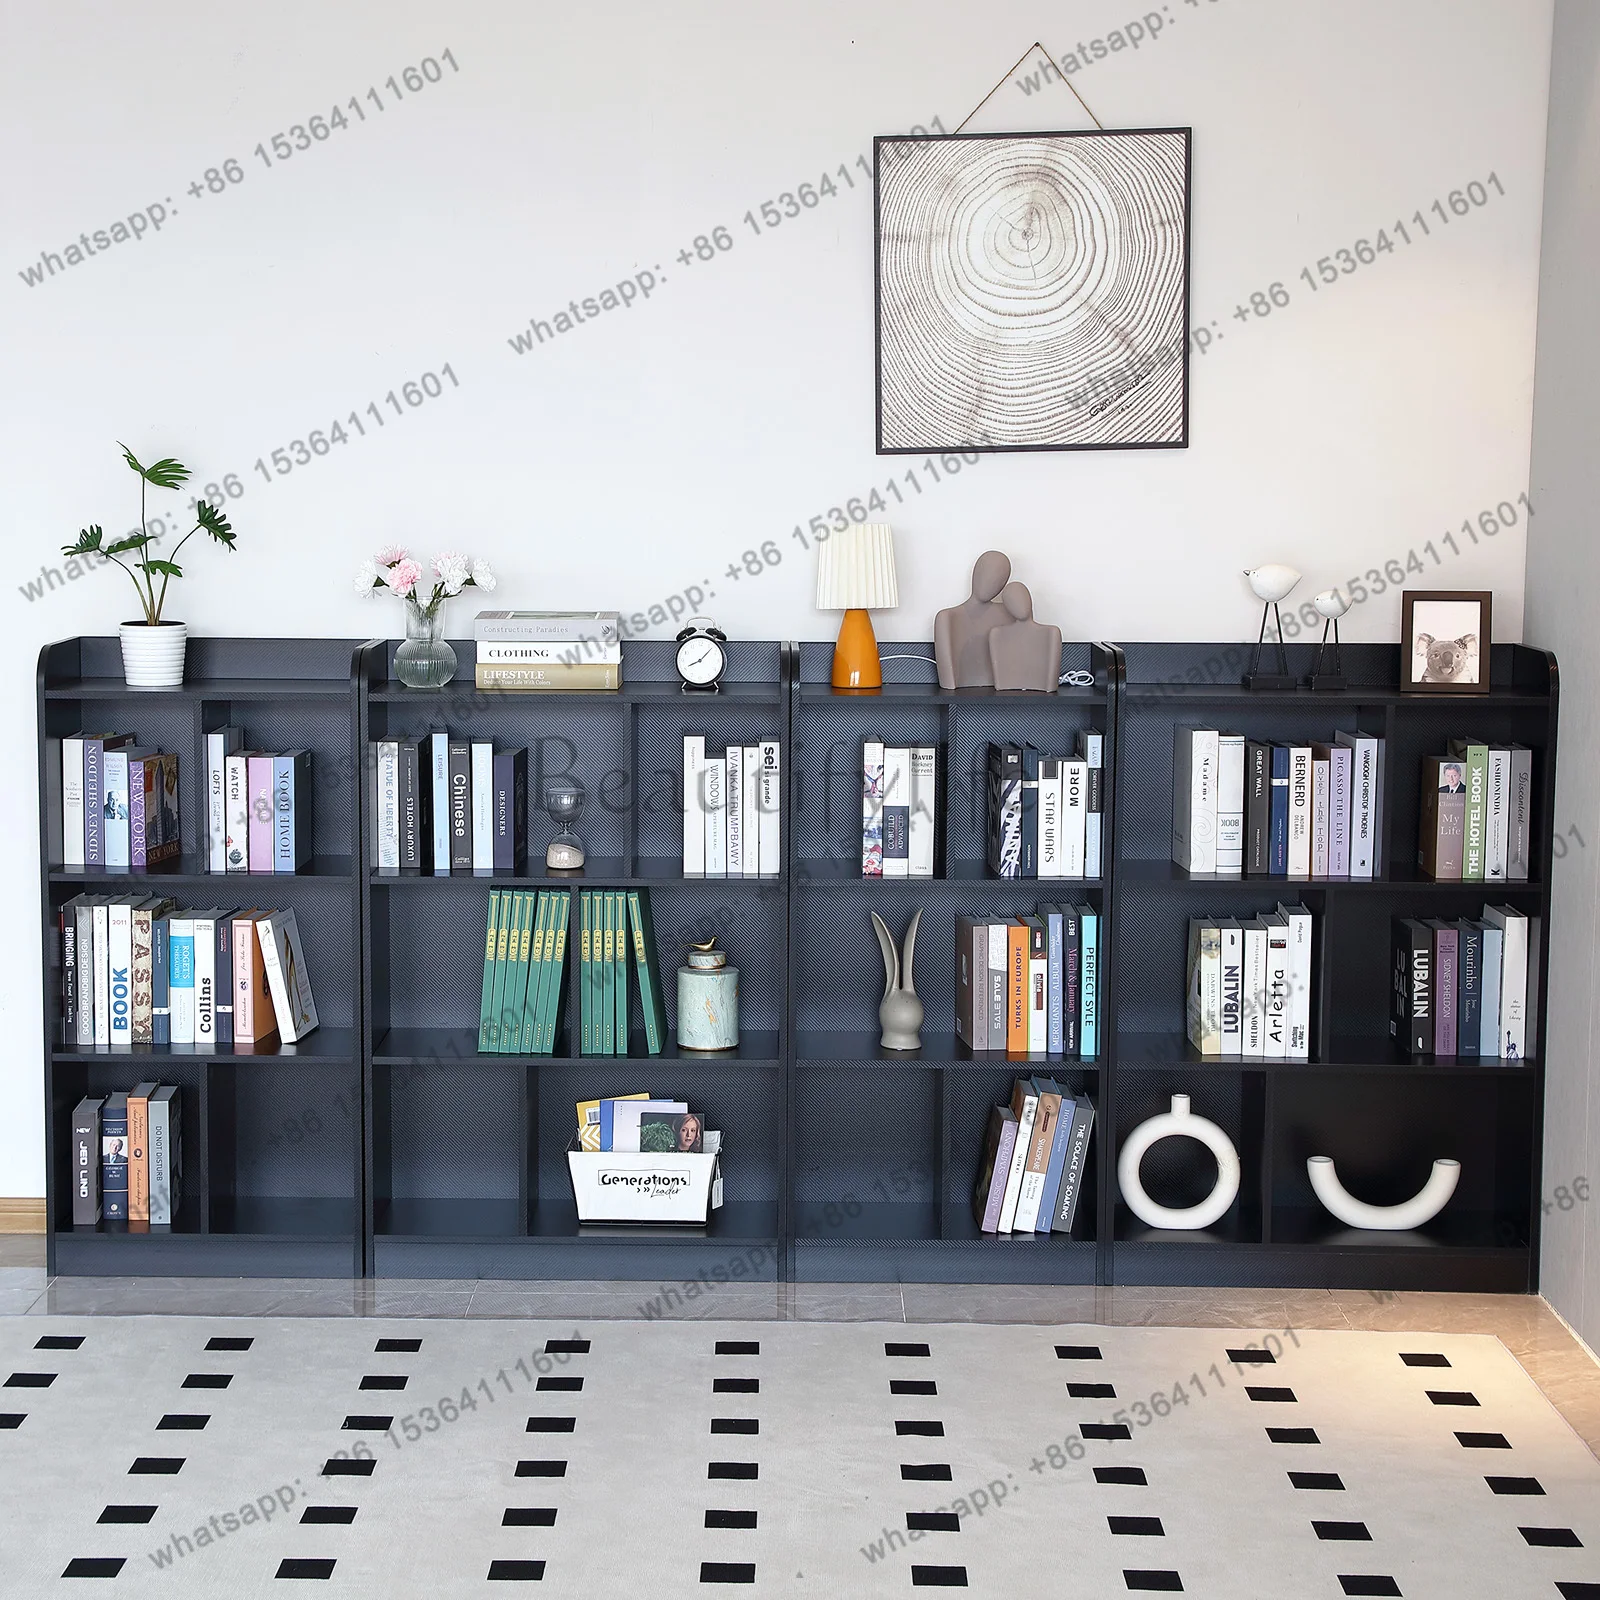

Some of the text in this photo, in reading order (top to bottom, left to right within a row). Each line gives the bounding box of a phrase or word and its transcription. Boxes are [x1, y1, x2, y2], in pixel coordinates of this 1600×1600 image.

[484, 670, 545, 679] LIFESTYLE
[488, 649, 549, 658] CLOTHING
[730, 751, 739, 792] IVANKA
[764, 746, 778, 770] sei
[911, 753, 934, 761] DAVID
[1255, 750, 1263, 775] GREAT
[1336, 756, 1344, 795] PICASSO
[88, 745, 98, 860] SIDNEY SHELDON
[212, 770, 221, 795] LOFTS
[231, 766, 239, 800] WATCH
[385, 753, 394, 839] STATUE OF LIBERTY
[710, 764, 720, 811] WINDOWS
[763, 779, 771, 804] grande
[1070, 767, 1080, 807] MORE
[1295, 755, 1306, 807] BERNERD
[1360, 749, 1370, 839] VANGOGH CHRISTOF THOENES
[132, 769, 145, 856] NEW YORK
[279, 770, 290, 859] HOME BOOK
[406, 797, 415, 861] LUXURY HOTELS
[453, 774, 467, 837] Chinese
[1045, 792, 1055, 863] STAR WARS
[1442, 814, 1460, 825] My
[1468, 766, 1482, 874] THE HOTEL BOOK
[1440, 827, 1461, 835] Life
[64, 926, 75, 967] BRINGING
[1068, 919, 1076, 936] BEST
[134, 919, 150, 1032] PASSY
[181, 945, 190, 980] ROGET'S
[1052, 962, 1060, 990] ALBUM
[1068, 948, 1078, 974] March
[1413, 949, 1429, 1018] LUBALIN
[1465, 936, 1478, 990] Mourinho
[113, 967, 128, 1030] BOOK
[200, 977, 211, 1033] Collins
[1015, 986, 1022, 996] IN
[1067, 983, 1077, 1014] January
[1085, 947, 1095, 1027] PERFECT SYLE
[1223, 965, 1240, 1034] LUBALIN
[1269, 969, 1285, 1043] Arletta
[1443, 958, 1452, 1018] SIDNEY SHELDON
[1052, 995, 1060, 1046] MERCHANTS
[1250, 1015, 1258, 1048] SHELDON
[1060, 1109, 1070, 1130] HOME
[79, 1140, 88, 1198] JED LIND
[155, 1125, 163, 1181] DO NOT DISTURB
[991, 1130, 1013, 1207] MUSIC SYMPHONY
[1060, 1124, 1086, 1220] THE SOLACE OF SOAKING
[601, 1173, 687, 1186] Generations
[650, 1180, 681, 1200] Leader
